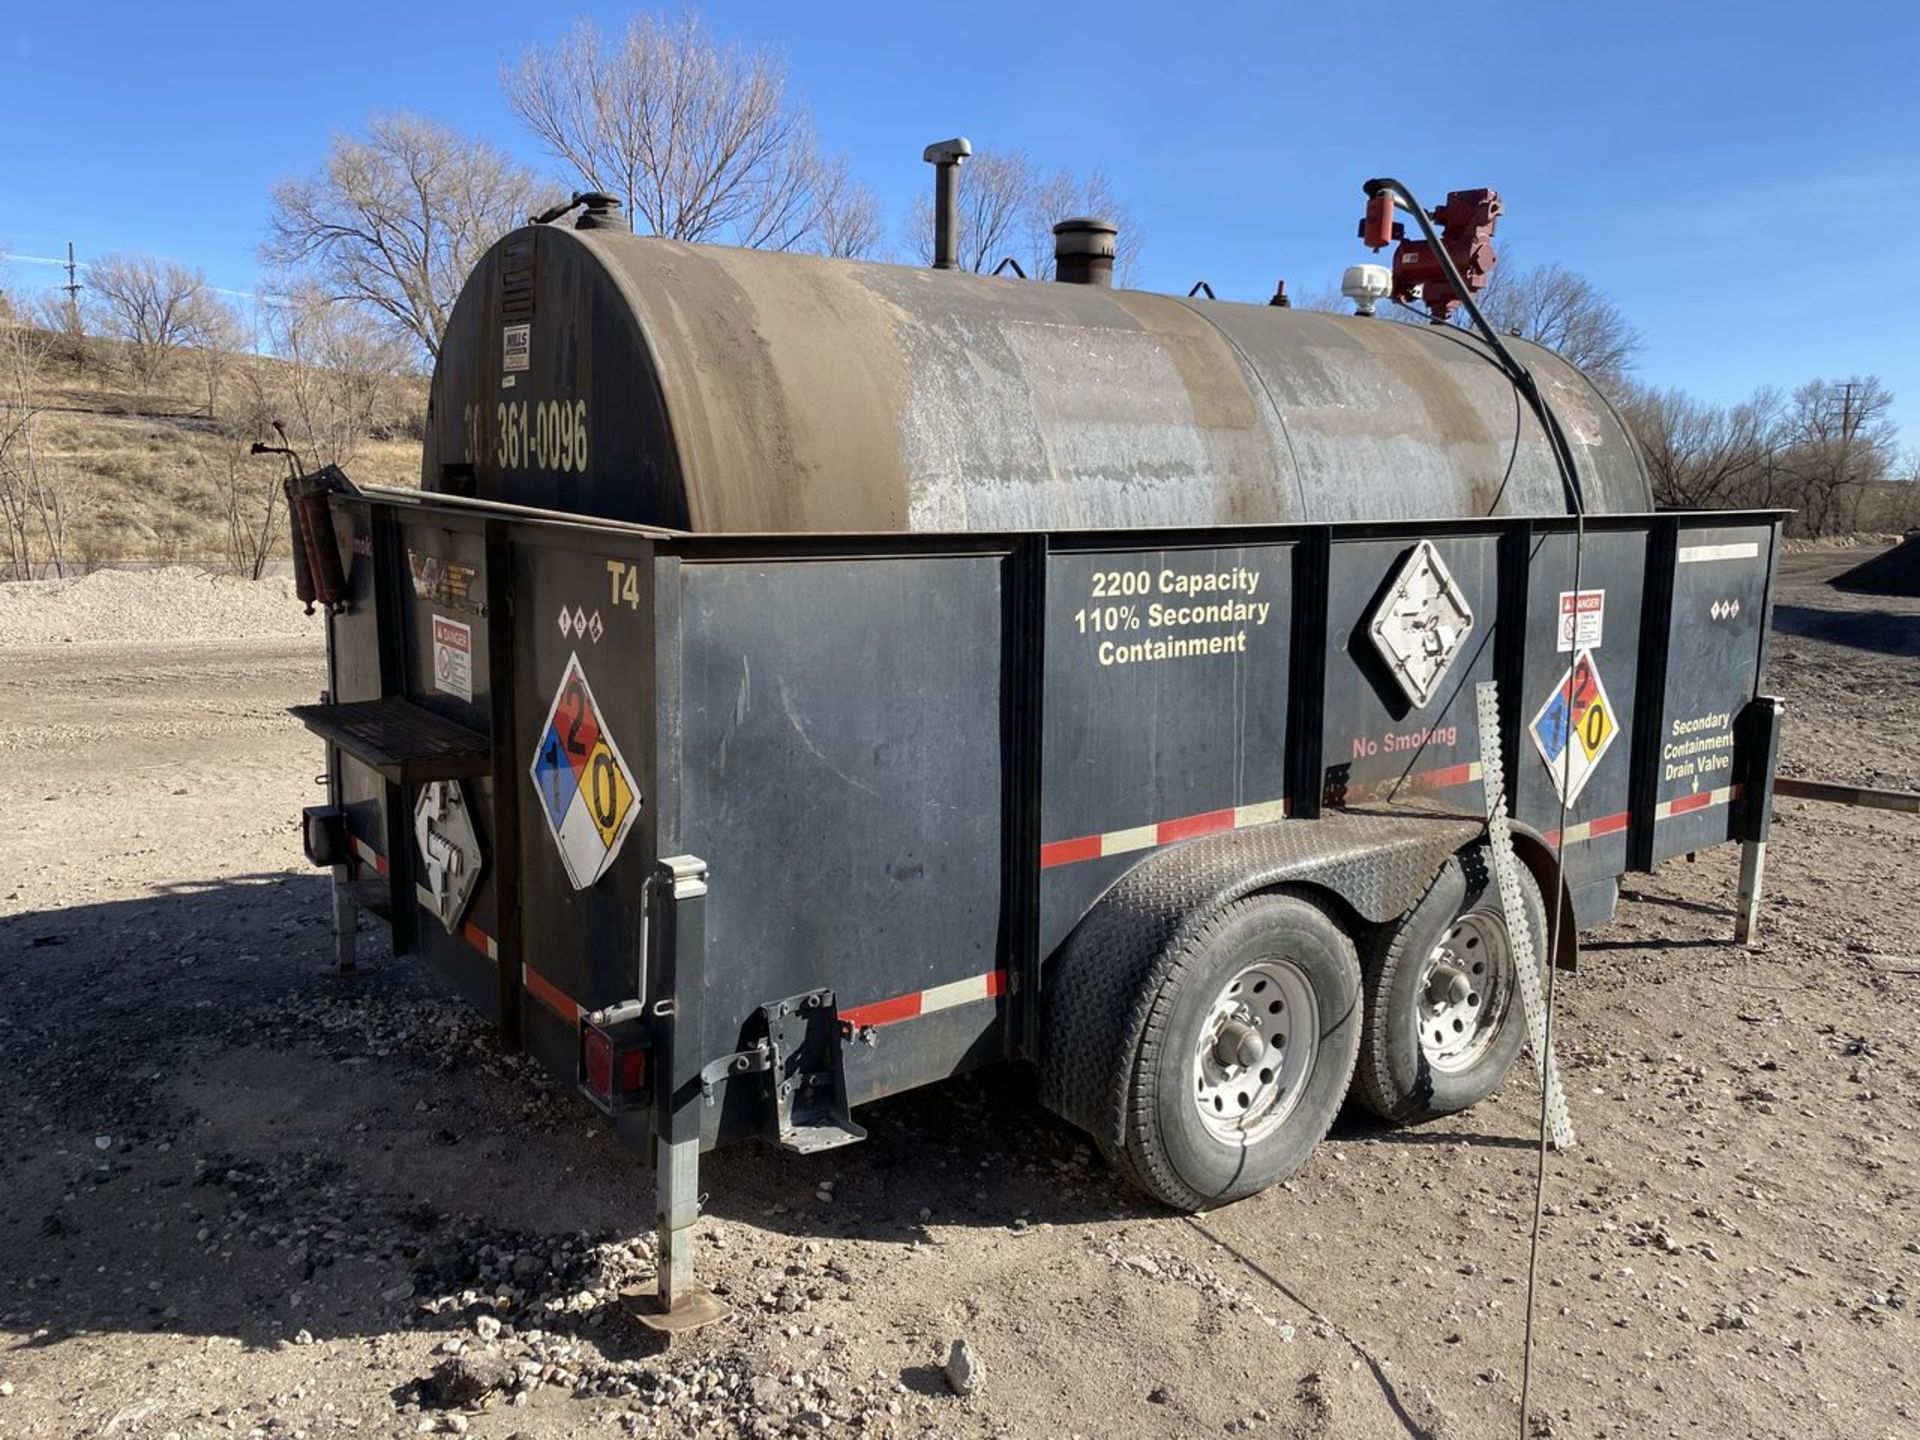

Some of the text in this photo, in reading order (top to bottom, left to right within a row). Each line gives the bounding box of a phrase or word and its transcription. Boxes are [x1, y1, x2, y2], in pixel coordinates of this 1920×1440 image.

[607, 560, 639, 610] T4
[1092, 567, 1260, 597] 2200 Capacity
[1074, 600, 1270, 634] 110% Secondary
[1098, 629, 1246, 666] Containment
[1574, 662, 1589, 708] 2
[566, 681, 586, 757] 2
[1587, 704, 1603, 750] 0
[1672, 712, 1730, 736] Secondary
[1353, 726, 1457, 758] No Smoking
[1664, 730, 1734, 760] Containment
[1665, 754, 1729, 781] Drain Valve
[592, 752, 617, 829] 0
